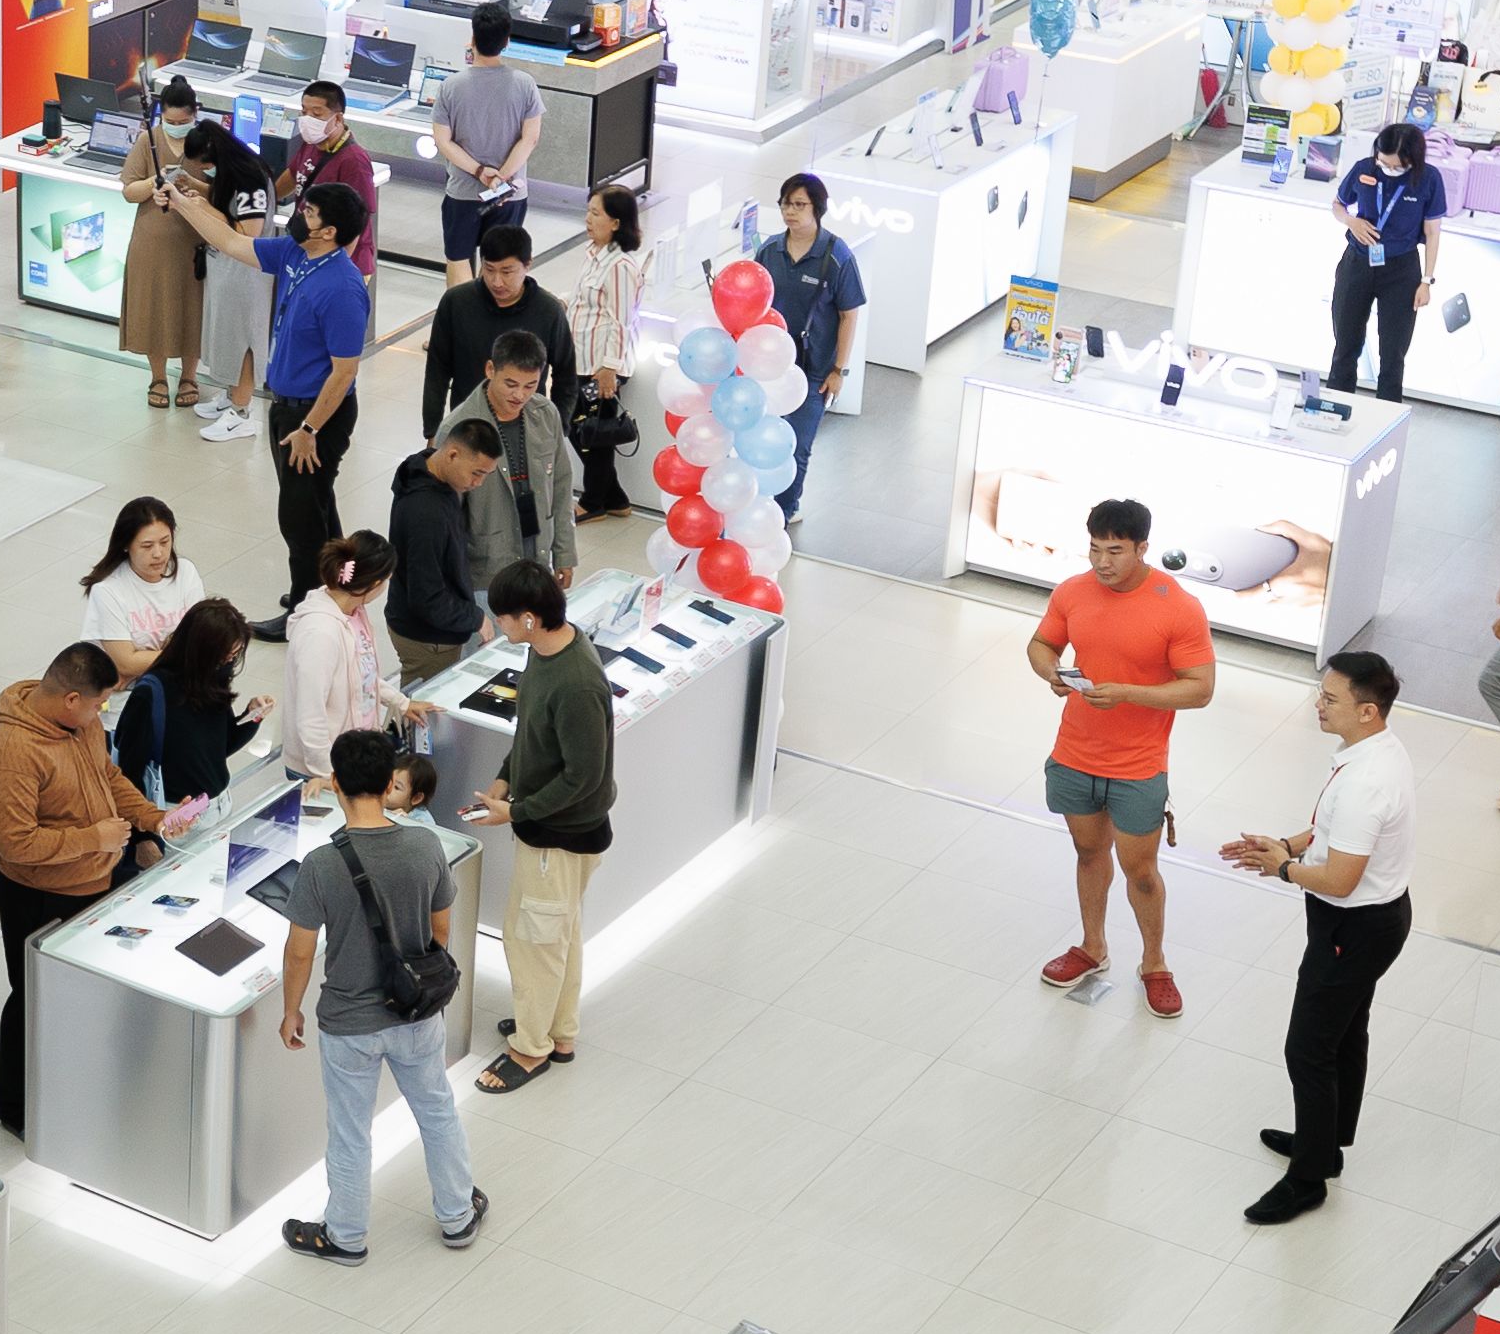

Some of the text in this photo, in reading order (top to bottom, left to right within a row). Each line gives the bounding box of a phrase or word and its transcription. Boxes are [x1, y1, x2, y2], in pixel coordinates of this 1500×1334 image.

[237, 189, 267, 213] 28
[828, 196, 915, 233] vivo
[1107, 330, 1279, 396] vivo
[1356, 448, 1396, 499] vivo
